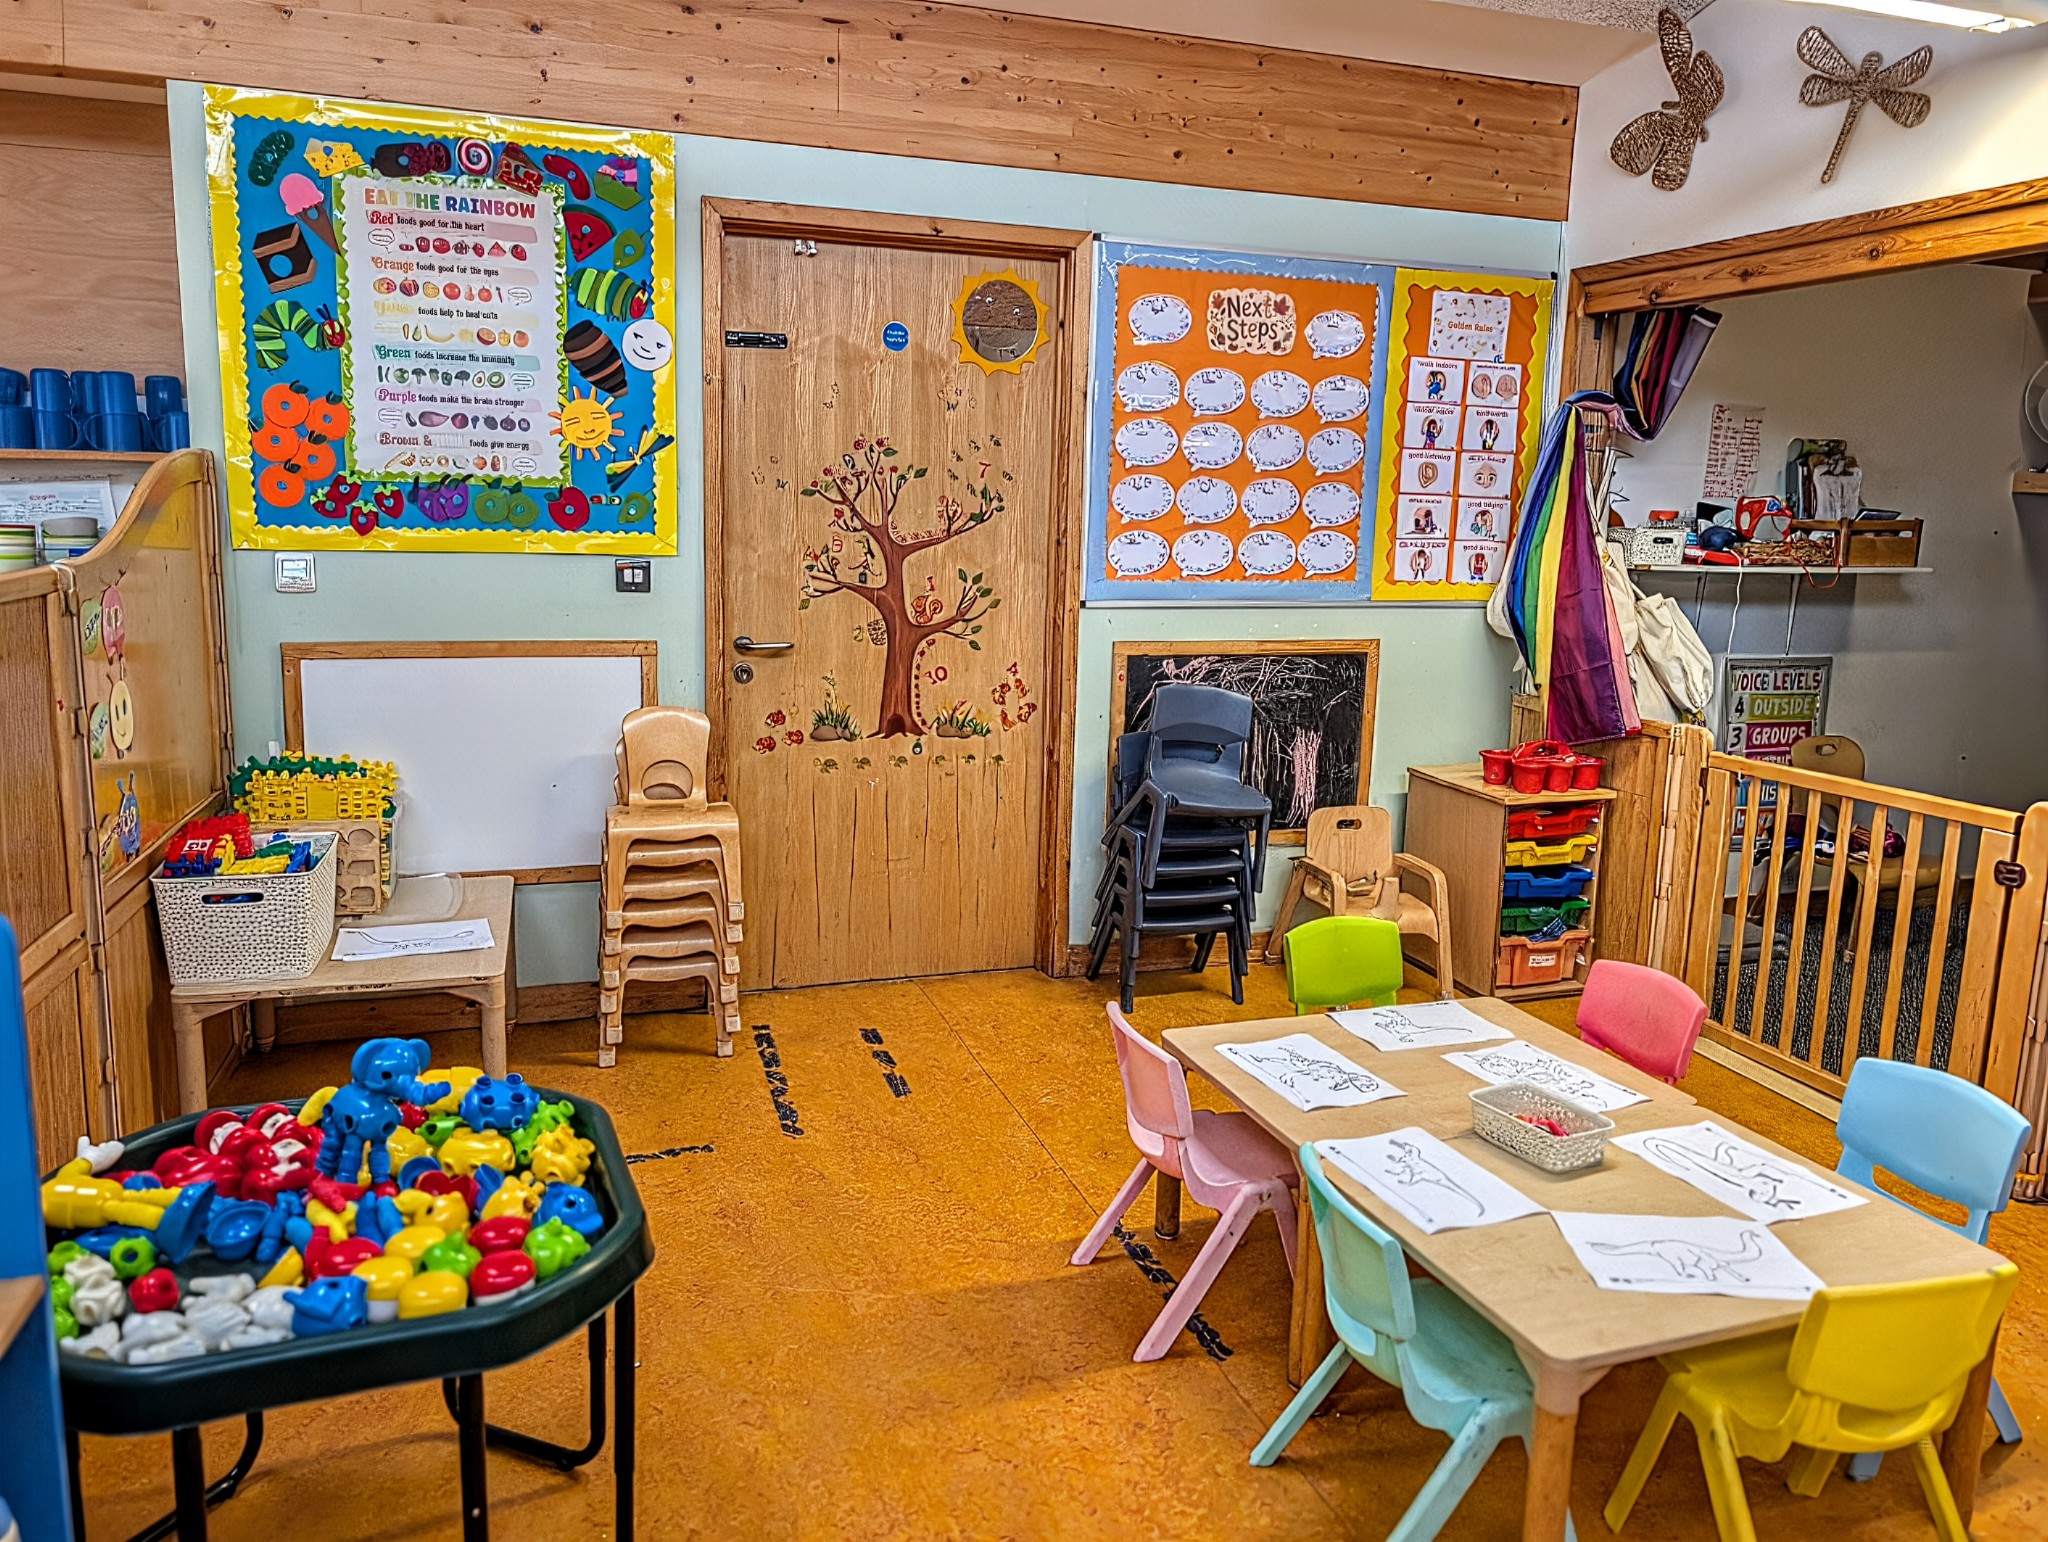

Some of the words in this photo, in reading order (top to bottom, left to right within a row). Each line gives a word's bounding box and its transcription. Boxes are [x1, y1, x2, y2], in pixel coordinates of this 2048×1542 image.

[364, 188, 400, 206] EAT
[405, 191, 440, 211] THE
[445, 194, 536, 219] RAINBOW
[370, 210, 394, 226] Red
[396, 216, 417, 226] foods
[418, 218, 436, 228] good
[438, 218, 448, 228] for
[452, 220, 463, 230] the
[464, 221, 485, 232] heart
[372, 256, 414, 274] Orange
[416, 262, 436, 272] foods
[438, 264, 454, 274] good
[456, 264, 468, 274] for
[470, 266, 482, 275] the
[418, 306, 438, 316] foods
[440, 308, 454, 319] help
[456, 310, 464, 318] to
[466, 310, 480, 320] heal
[482, 312, 498, 320] cuts
[1226, 296, 1272, 318] Next
[1226, 320, 1278, 342] Steps
[1448, 321, 1472, 331] Golden
[1474, 323, 1494, 333] Rules
[375, 344, 412, 360] Green
[414, 350, 434, 360] foods
[436, 352, 467, 362] increase
[469, 353, 480, 362] the
[482, 354, 516, 366] immunity
[378, 388, 417, 404] Purple
[418, 394, 438, 403] foods
[440, 394, 459, 404] make
[460, 395, 472, 404] the
[474, 396, 493, 406] brain
[494, 398, 525, 408] stronger
[380, 432, 420, 446] Brown
[423, 435, 434, 446] &
[470, 439, 488, 448] foods
[490, 440, 505, 450] give
[506, 442, 530, 451] energy
[1408, 452, 1424, 460] good
[978, 461, 992, 479] 7
[1732, 672, 1770, 692] VOICE
[1773, 671, 1822, 690] LEVELS
[1734, 695, 1745, 718] 4
[1754, 696, 1811, 716] OUTSIDE
[1729, 726, 1742, 749] 3
[1752, 726, 1806, 745] GROUPS
